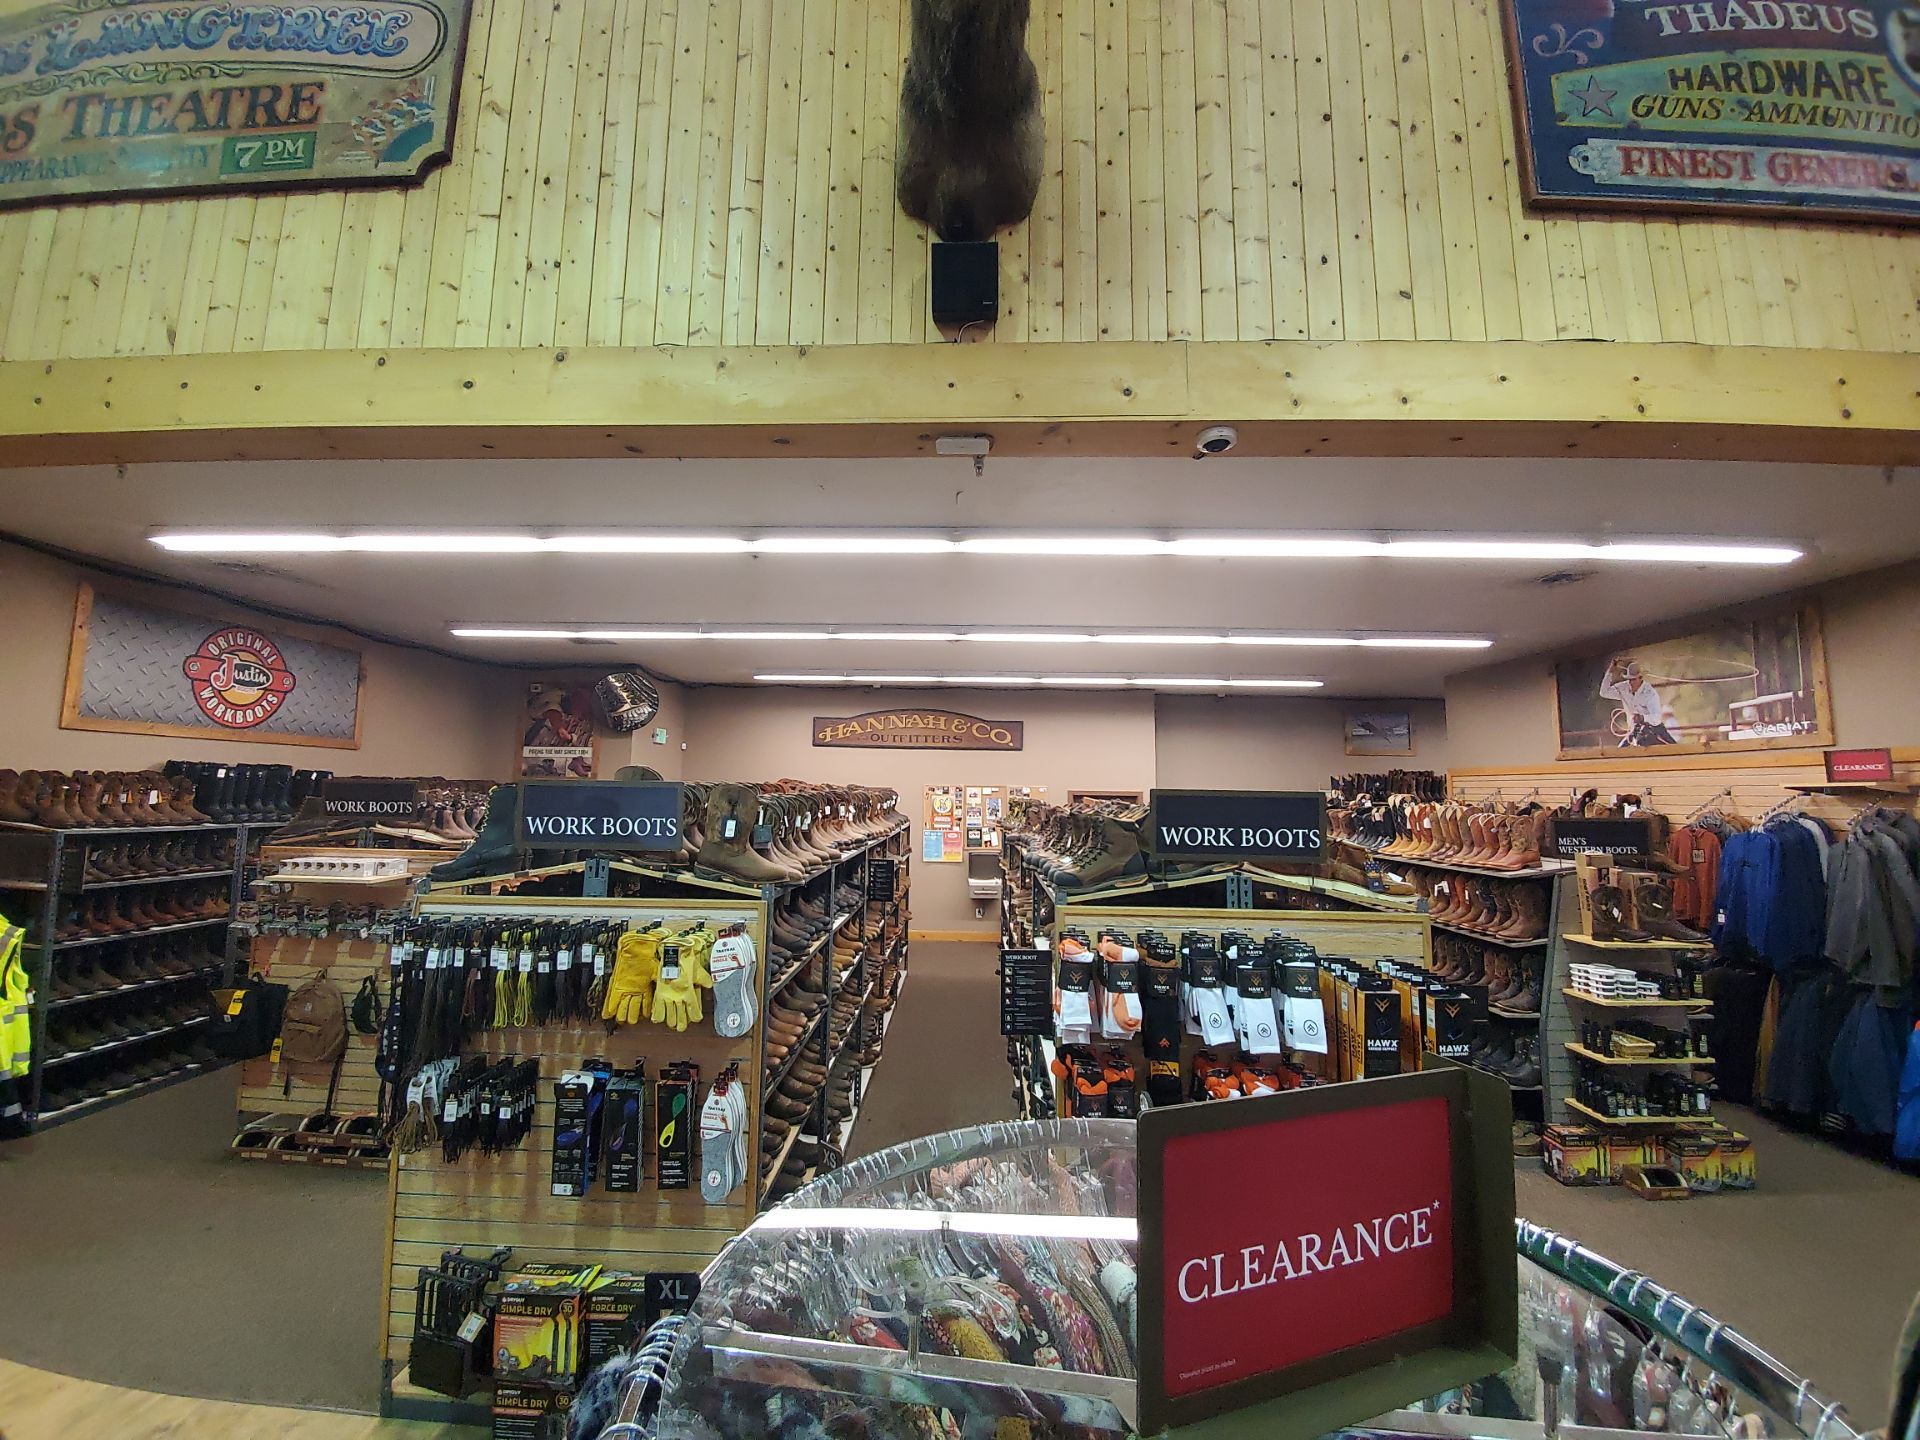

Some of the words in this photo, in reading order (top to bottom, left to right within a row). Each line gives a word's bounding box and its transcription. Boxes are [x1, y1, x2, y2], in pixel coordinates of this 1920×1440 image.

[1645, 0, 1879, 38] THADEUS
[36, 2, 413, 75] LANGTREE
[1668, 60, 1896, 107] HARDWARE
[62, 82, 327, 142] THEATRE
[1631, 94, 1725, 120] GUNS
[233, 141, 263, 168] 7
[266, 138, 305, 160] PM
[1616, 145, 1758, 182] FINEST
[207, 632, 278, 665] ORIGINAL
[210, 654, 267, 690] Justin
[199, 687, 279, 724] WORKBOOTS
[818, 714, 947, 742] HANNAH
[1766, 721, 1811, 733] ARIAT
[870, 733, 963, 743] OUTFITTERS
[325, 800, 367, 813] WORK
[368, 801, 413, 814] BOOTS
[526, 816, 596, 835] WORK
[601, 817, 677, 837] BOOTS
[1160, 826, 1235, 847] WORK
[1240, 827, 1321, 849] BOOTS
[1558, 837, 1587, 846] MEN'S
[1605, 846, 1638, 854] BOOTS
[1367, 1039, 1398, 1047] HAWX
[1439, 1045, 1469, 1053] HAWX
[823, 1148, 837, 1169] XS
[659, 1279, 689, 1300] XL
[500, 1304, 533, 1315] SIMPLE
[534, 1306, 553, 1316] DRY
[563, 1305, 573, 1313] 30
[590, 1303, 616, 1312] FORCE
[617, 1304, 633, 1313] DRY
[496, 1397, 528, 1408] SIMPLE
[530, 1399, 549, 1408] DRY
[559, 1396, 569, 1405] 30
